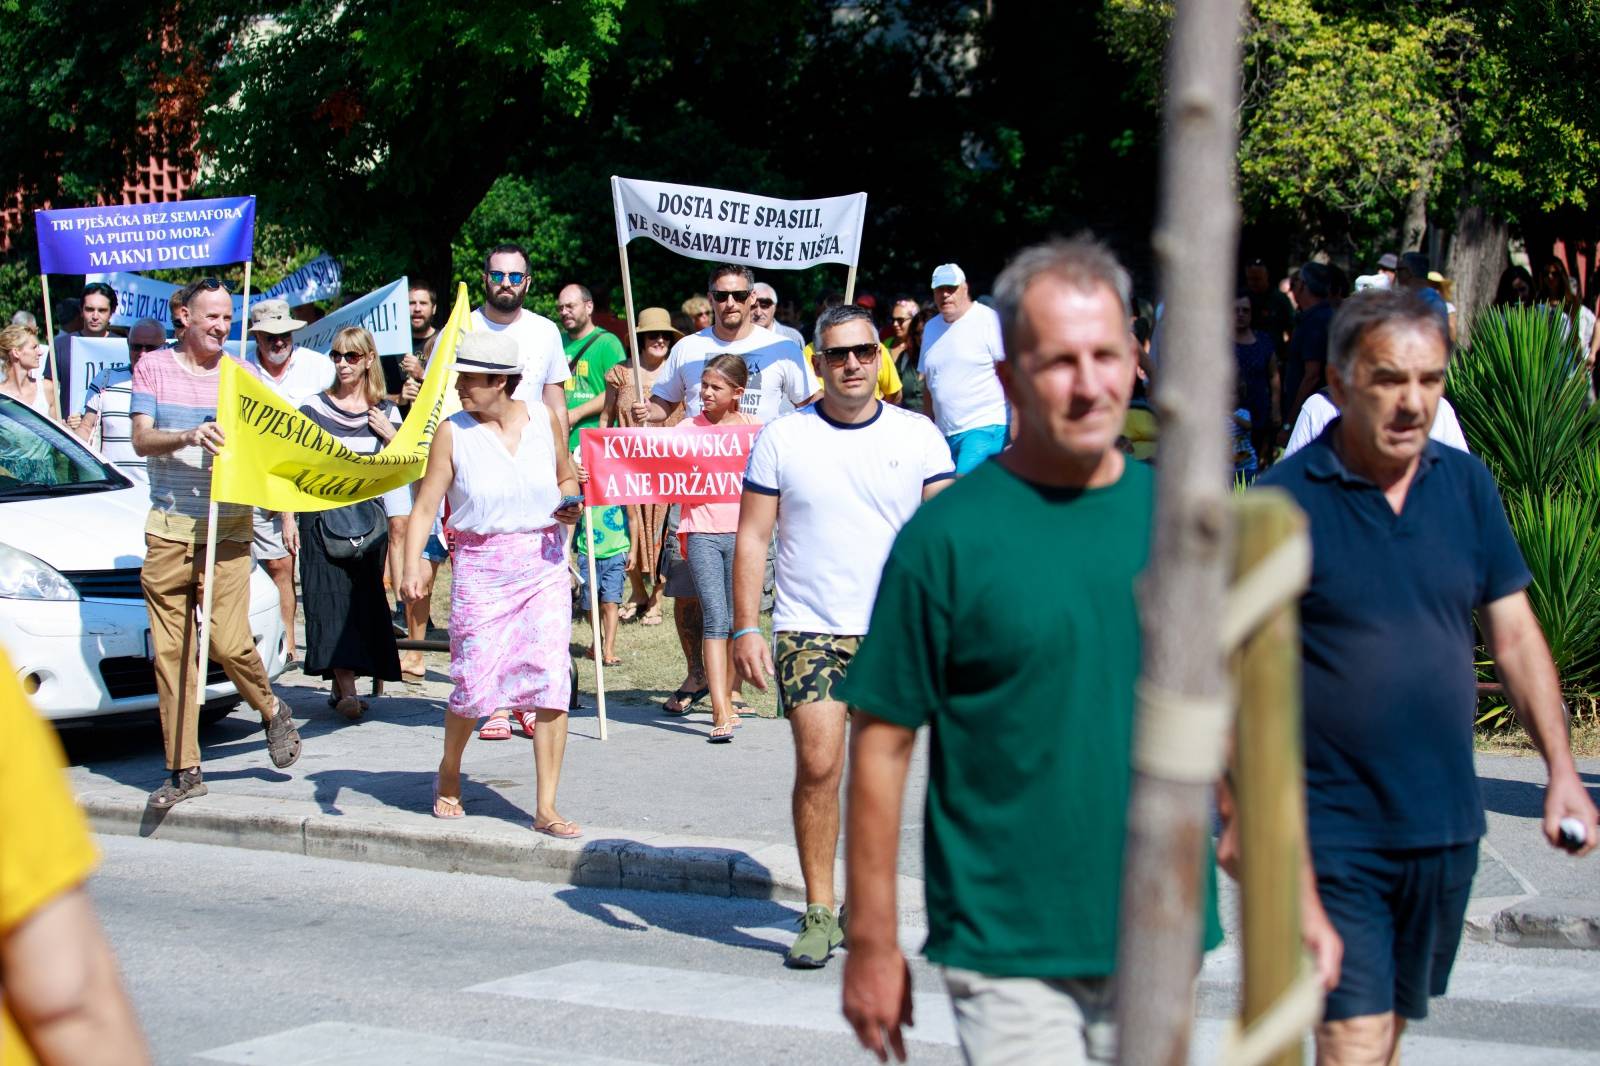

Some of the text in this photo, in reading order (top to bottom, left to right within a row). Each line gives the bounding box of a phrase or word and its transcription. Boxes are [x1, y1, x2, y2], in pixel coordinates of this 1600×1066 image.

[51, 207, 243, 231] TRI PJEŠAČKA BEZ SEMAFORA
[656, 192, 713, 220] DOSTA
[718, 199, 750, 225] STE
[84, 226, 215, 245] NA PUTU DO MORA.
[627, 212, 844, 262] NE SPAŠAVAJTE VIŠE NIŠTA.
[89, 244, 210, 268] MAKNI DICU!
[603, 432, 744, 460] KVARTOVSKA
[604, 465, 744, 498] A NE DRŽAVN
